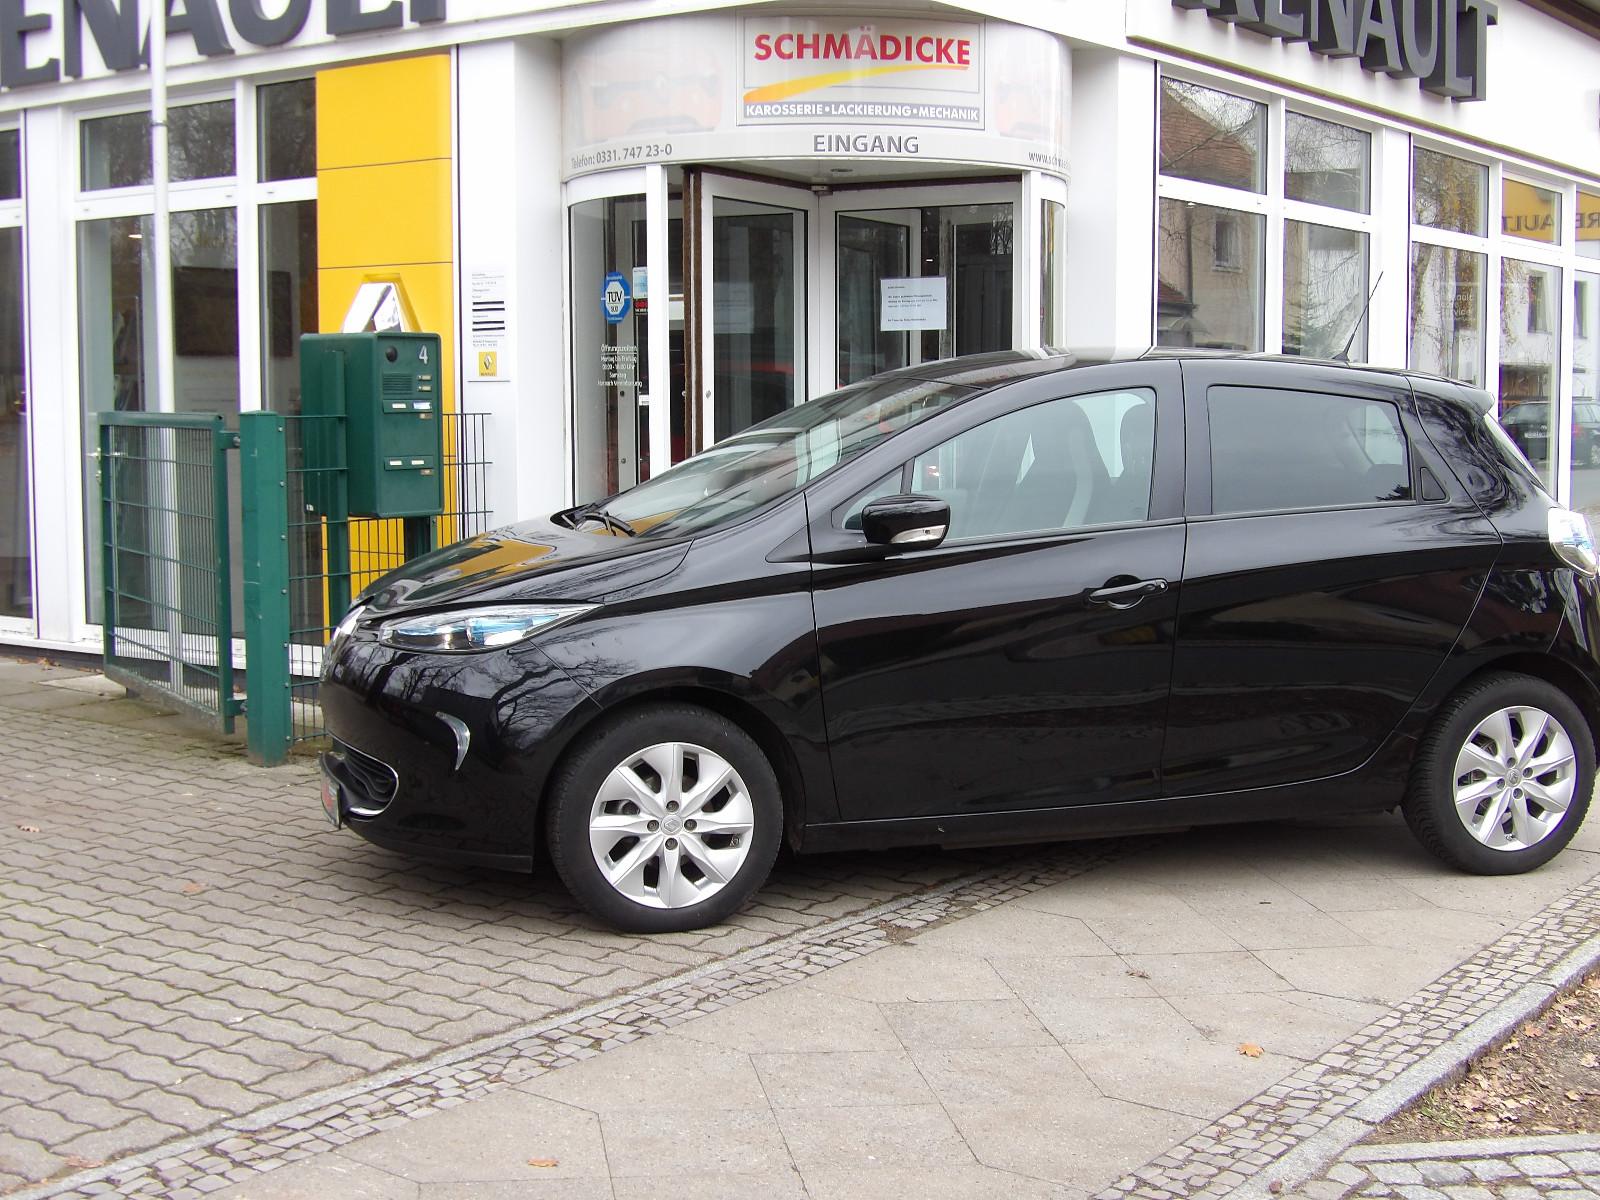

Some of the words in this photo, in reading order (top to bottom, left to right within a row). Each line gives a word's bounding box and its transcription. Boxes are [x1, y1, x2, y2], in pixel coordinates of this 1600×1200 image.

[754, 25, 971, 65] SCHMÄDICKE
[1172, 0, 1499, 102] NAULT
[746, 103, 823, 116] KAROSSERIE
[831, 103, 912, 118] LACKIERUNG
[918, 107, 979, 122] MECHANIK
[813, 133, 919, 154] EINGANG
[571, 153, 595, 169] Telefon:
[623, 146, 643, 160] 747
[645, 143, 673, 158] 23-0
[418, 344, 429, 365] 4
